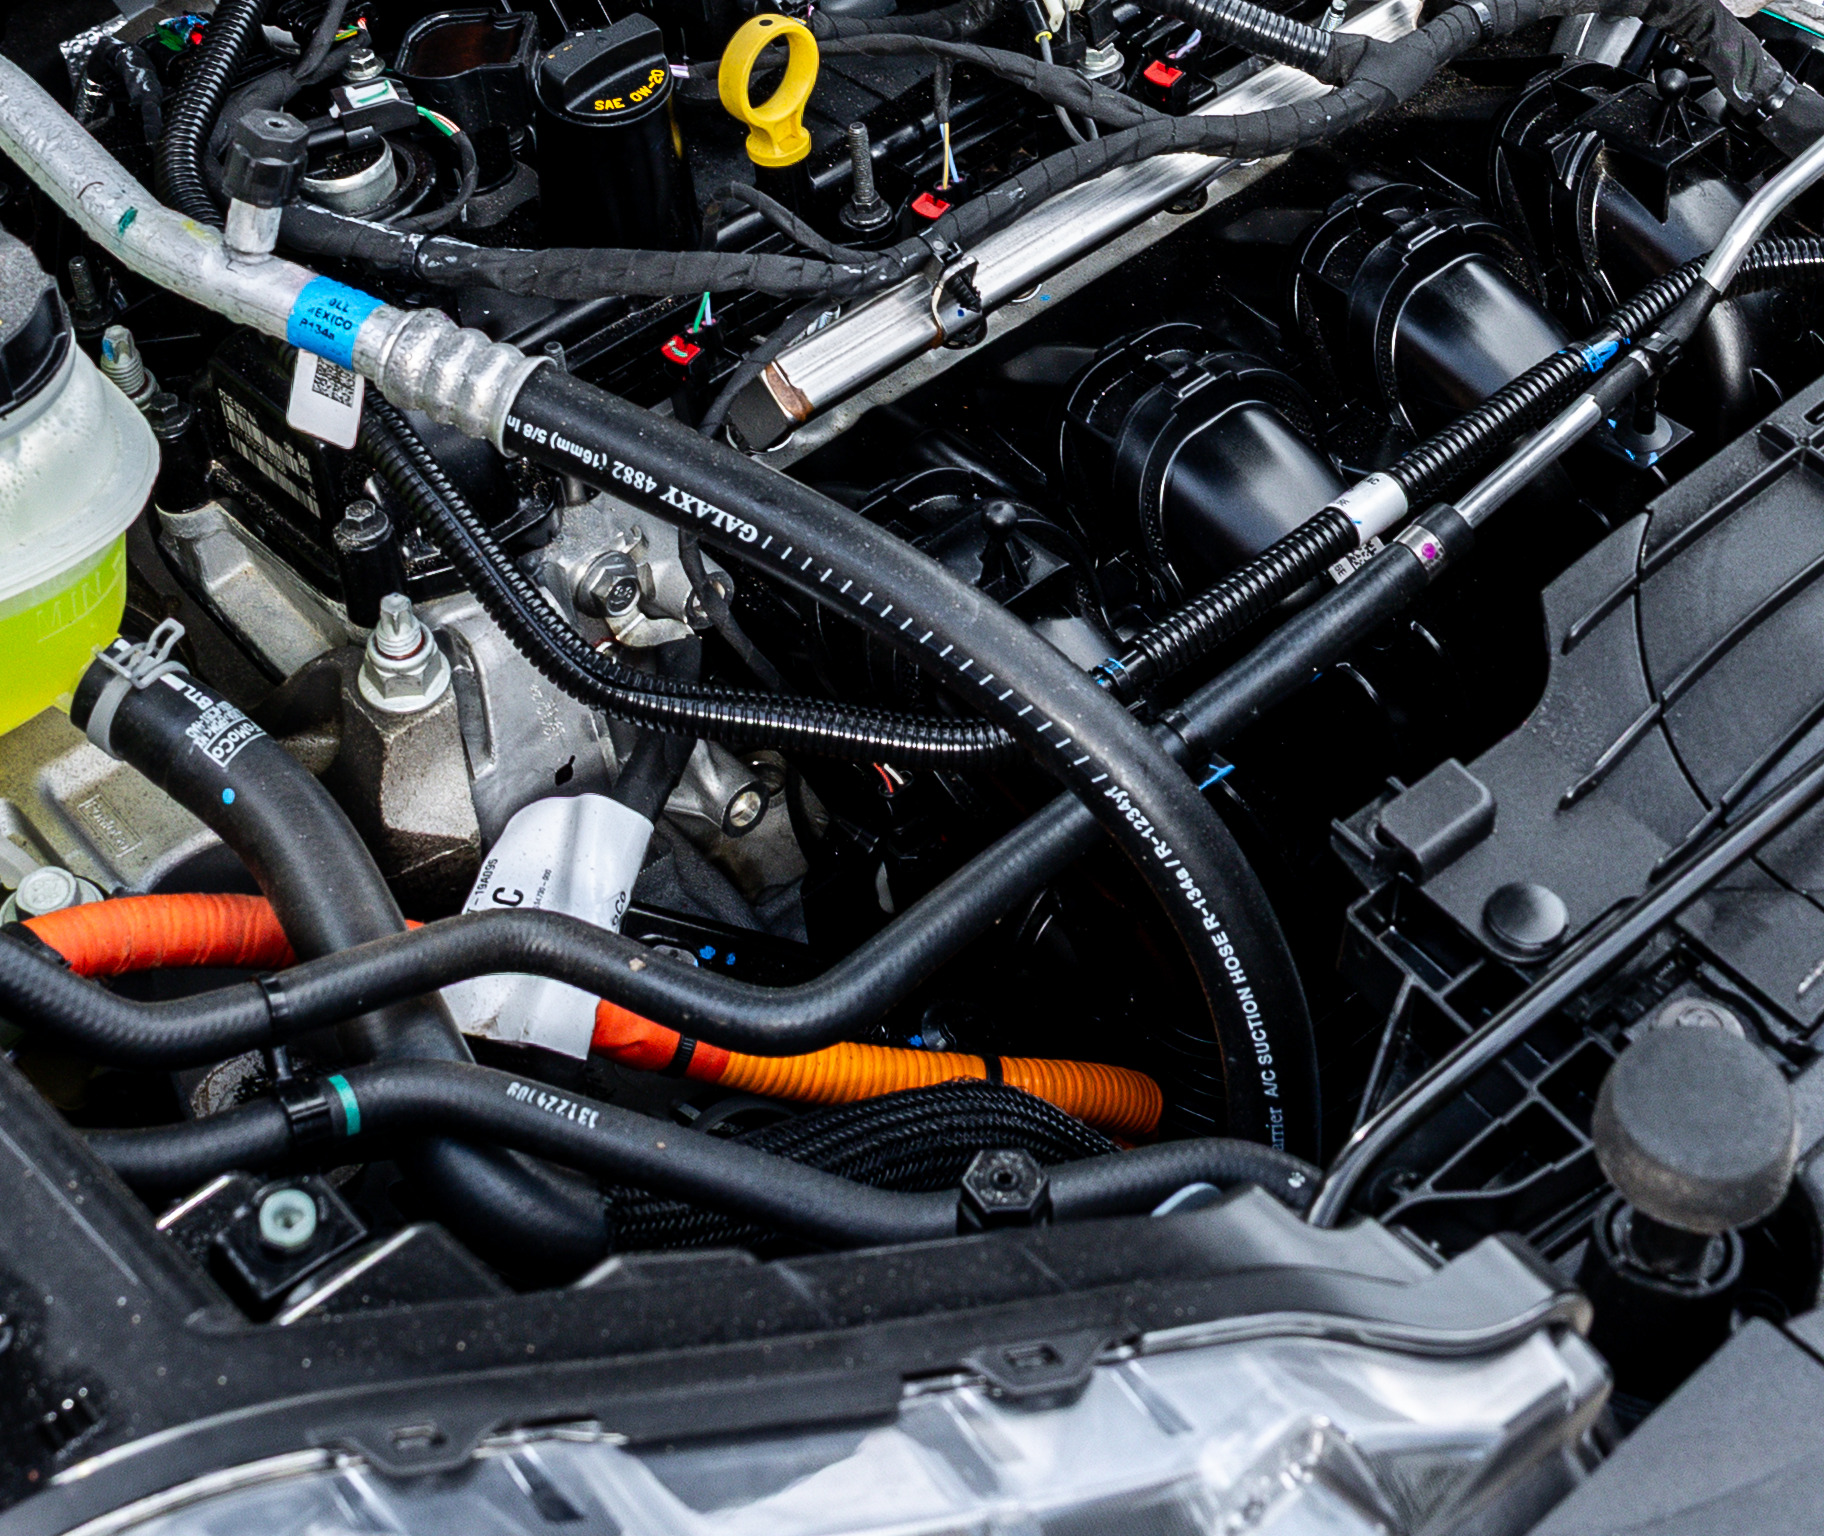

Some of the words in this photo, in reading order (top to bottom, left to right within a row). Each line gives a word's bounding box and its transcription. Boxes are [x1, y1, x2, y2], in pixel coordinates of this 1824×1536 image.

[594, 97, 625, 111] SAE
[629, 69, 665, 102] 0W-20
[522, 422, 548, 444] 5/8
[549, 431, 608, 471] (16mm)
[611, 460, 658, 493] 4882
[660, 485, 758, 543] GALAXY
[184, 684, 214, 711] BTL
[212, 720, 263, 759] FoMoCo
[1104, 785, 1172, 859] R-1234yf
[611, 891, 626, 926] oCo
[1176, 867, 1220, 931] R-134a
[1211, 931, 1247, 984] HOSE
[1237, 987, 1273, 1065] SUCTION
[1261, 1070, 1279, 1097] A/C
[1269, 1107, 1284, 1152] arrier
